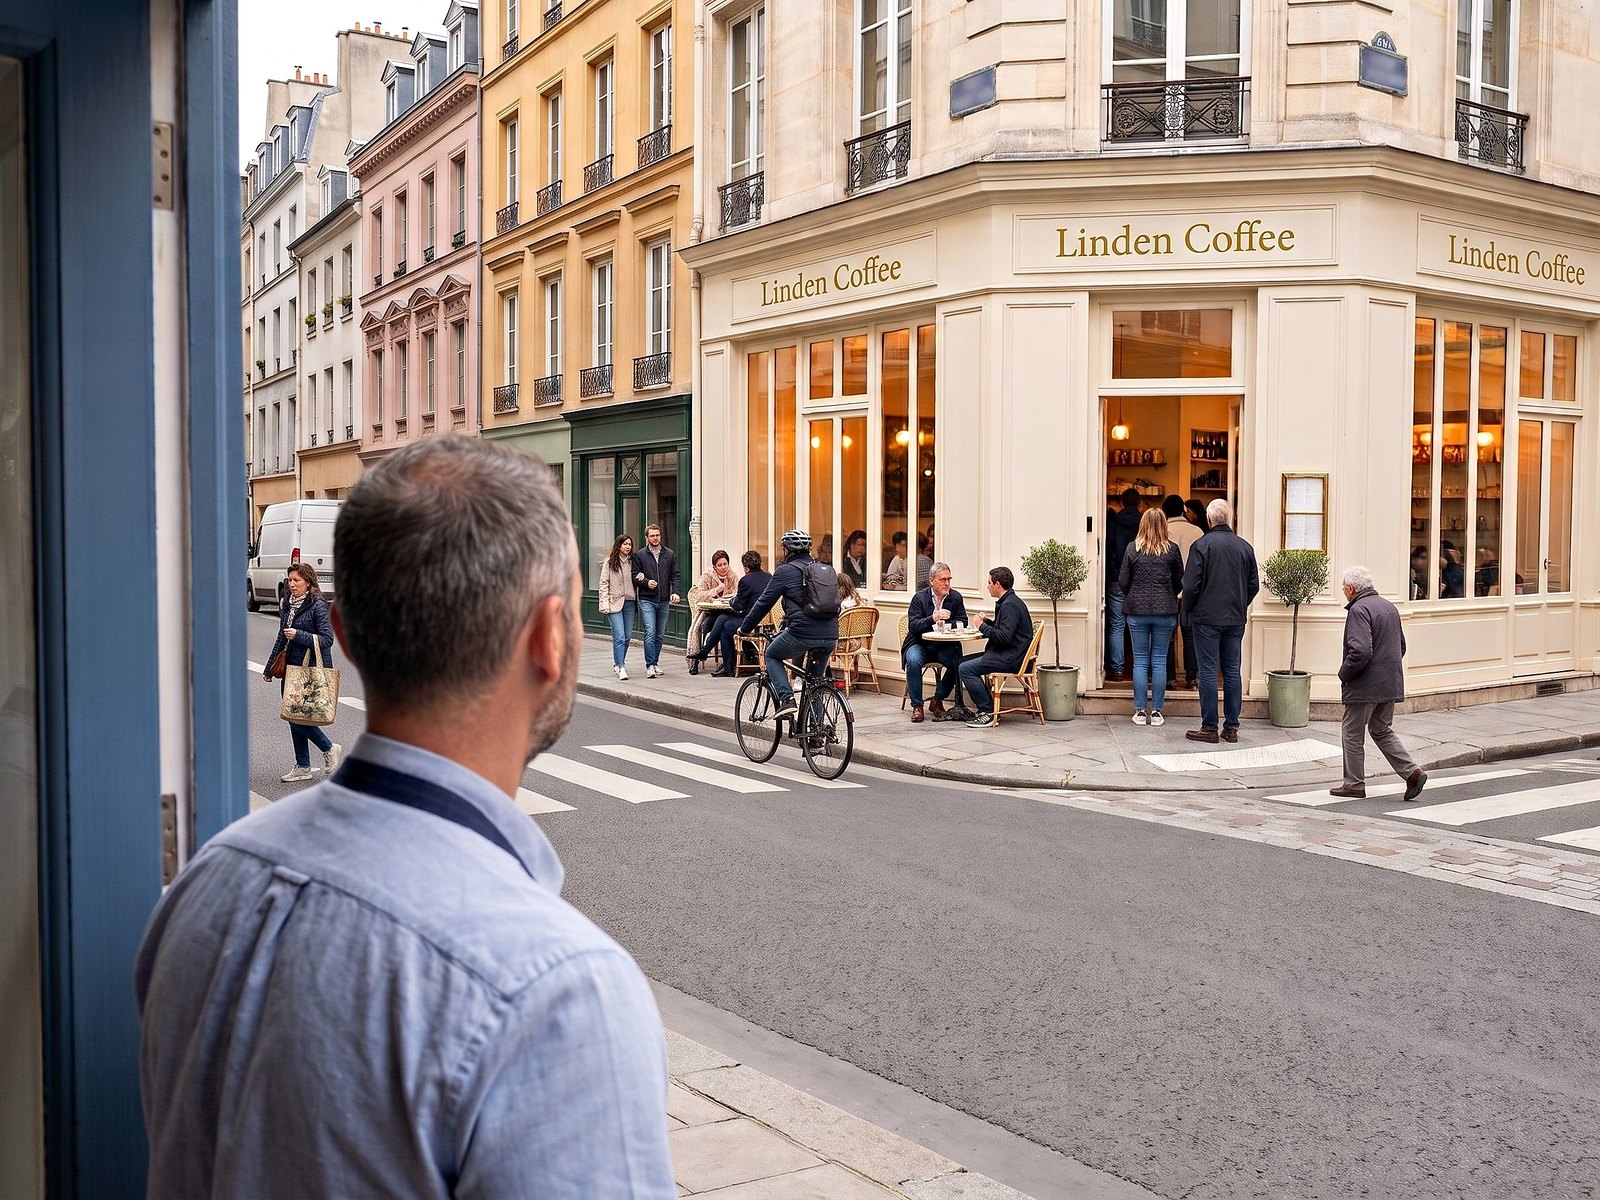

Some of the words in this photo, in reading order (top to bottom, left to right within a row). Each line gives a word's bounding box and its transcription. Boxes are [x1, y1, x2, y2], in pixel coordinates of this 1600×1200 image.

[1056, 223, 1174, 258] Linden
[1184, 219, 1295, 253] Coffee
[1449, 235, 1520, 275] Linden
[1525, 250, 1586, 286] Coffee
[760, 272, 828, 307] Linden
[833, 254, 902, 291] Coffee
